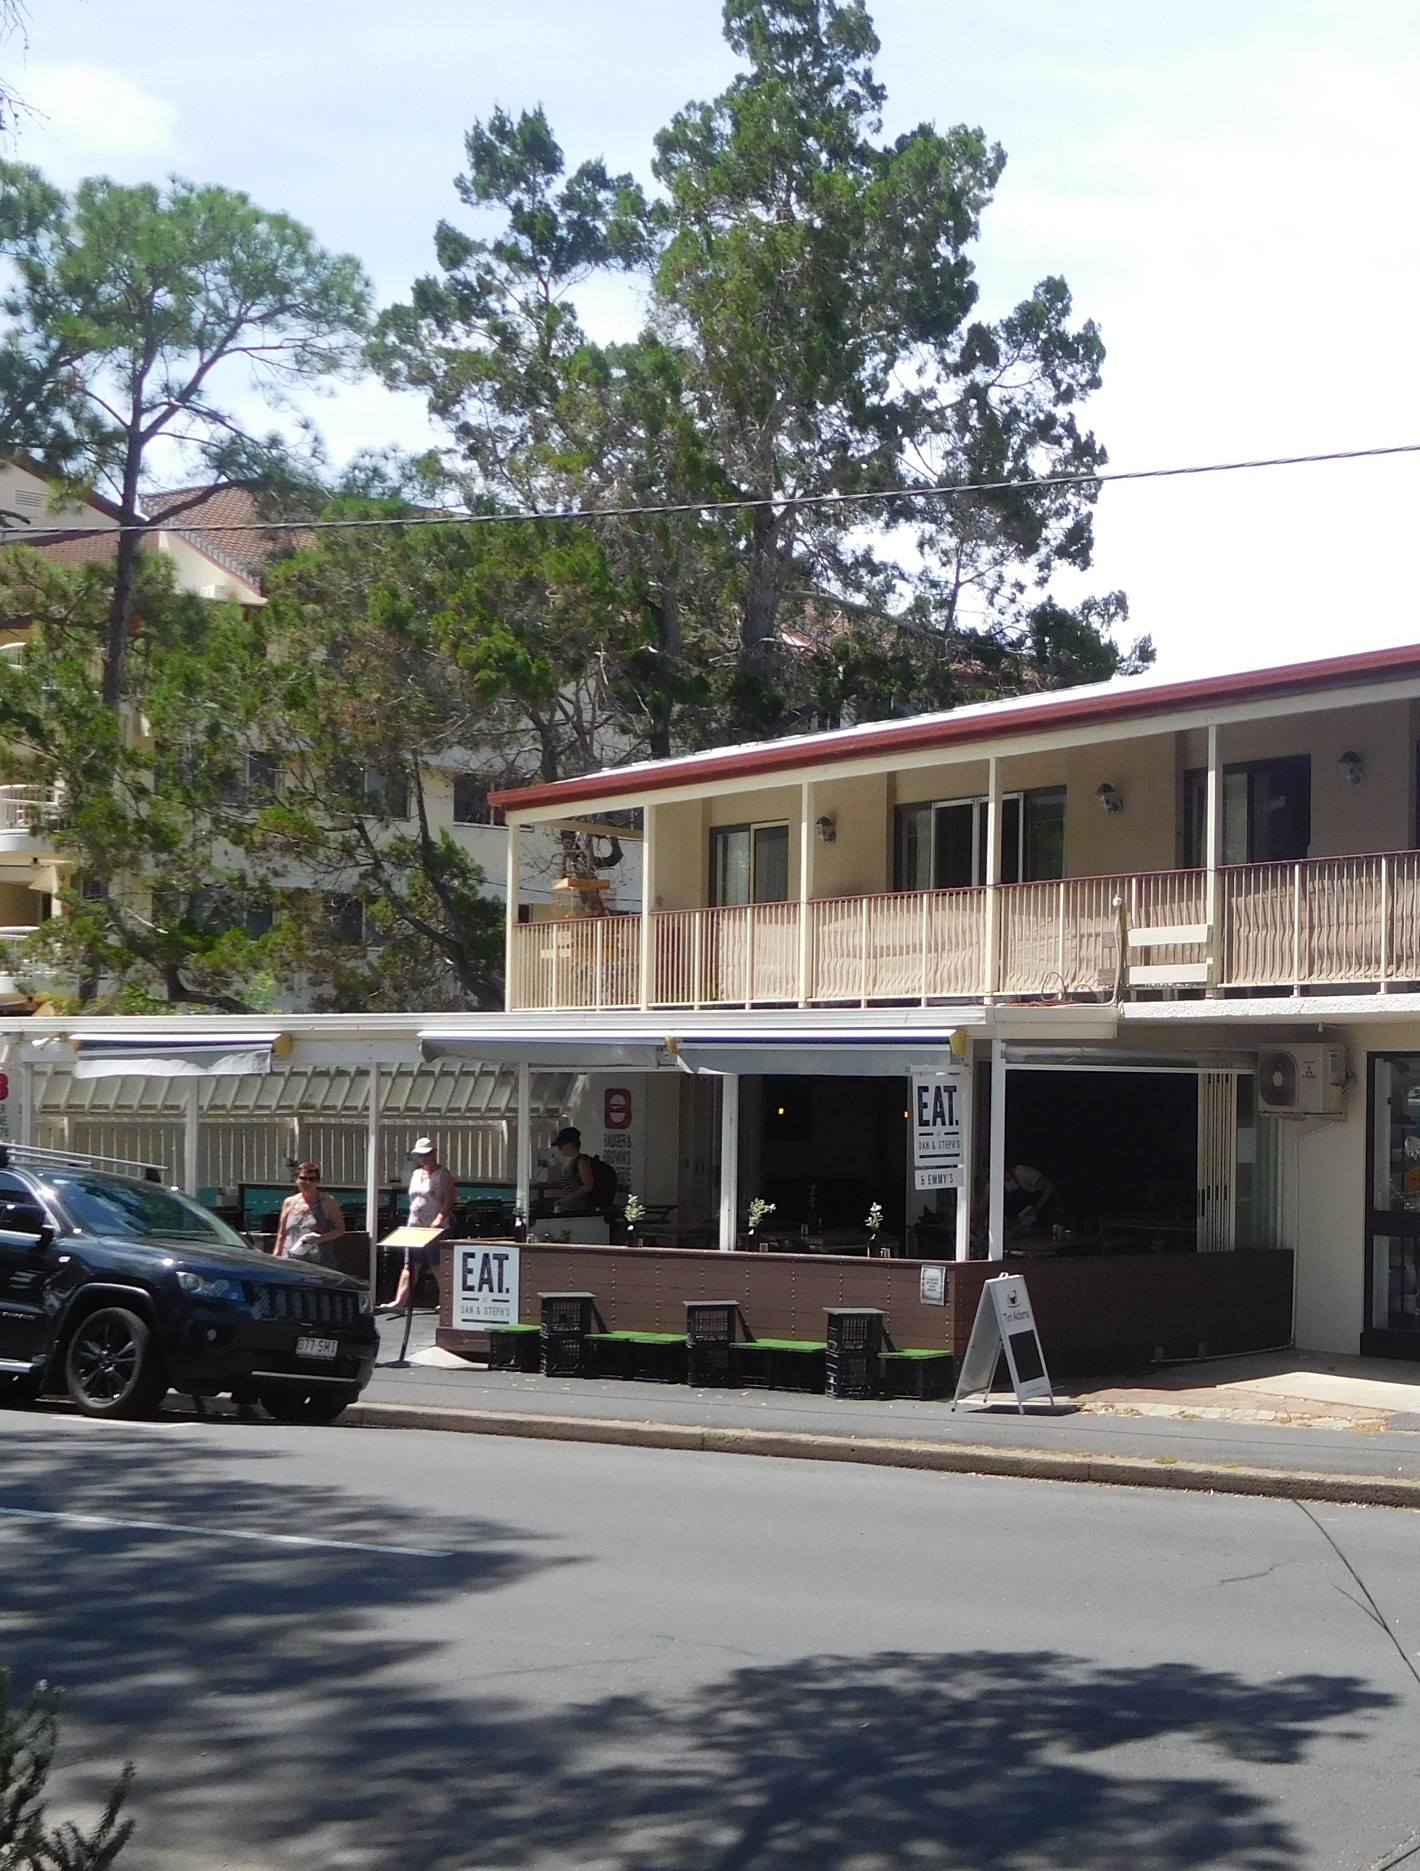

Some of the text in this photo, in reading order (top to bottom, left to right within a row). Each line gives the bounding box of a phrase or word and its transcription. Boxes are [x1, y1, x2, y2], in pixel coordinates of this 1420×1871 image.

[917, 1085, 960, 1127] EAT.
[918, 1141, 930, 1151] DAN
[931, 1141, 936, 1150] &
[920, 1173, 954, 1186] & EMMY'S
[461, 1251, 510, 1294] EAT.
[460, 1305, 510, 1317] DAN & STEPH'S
